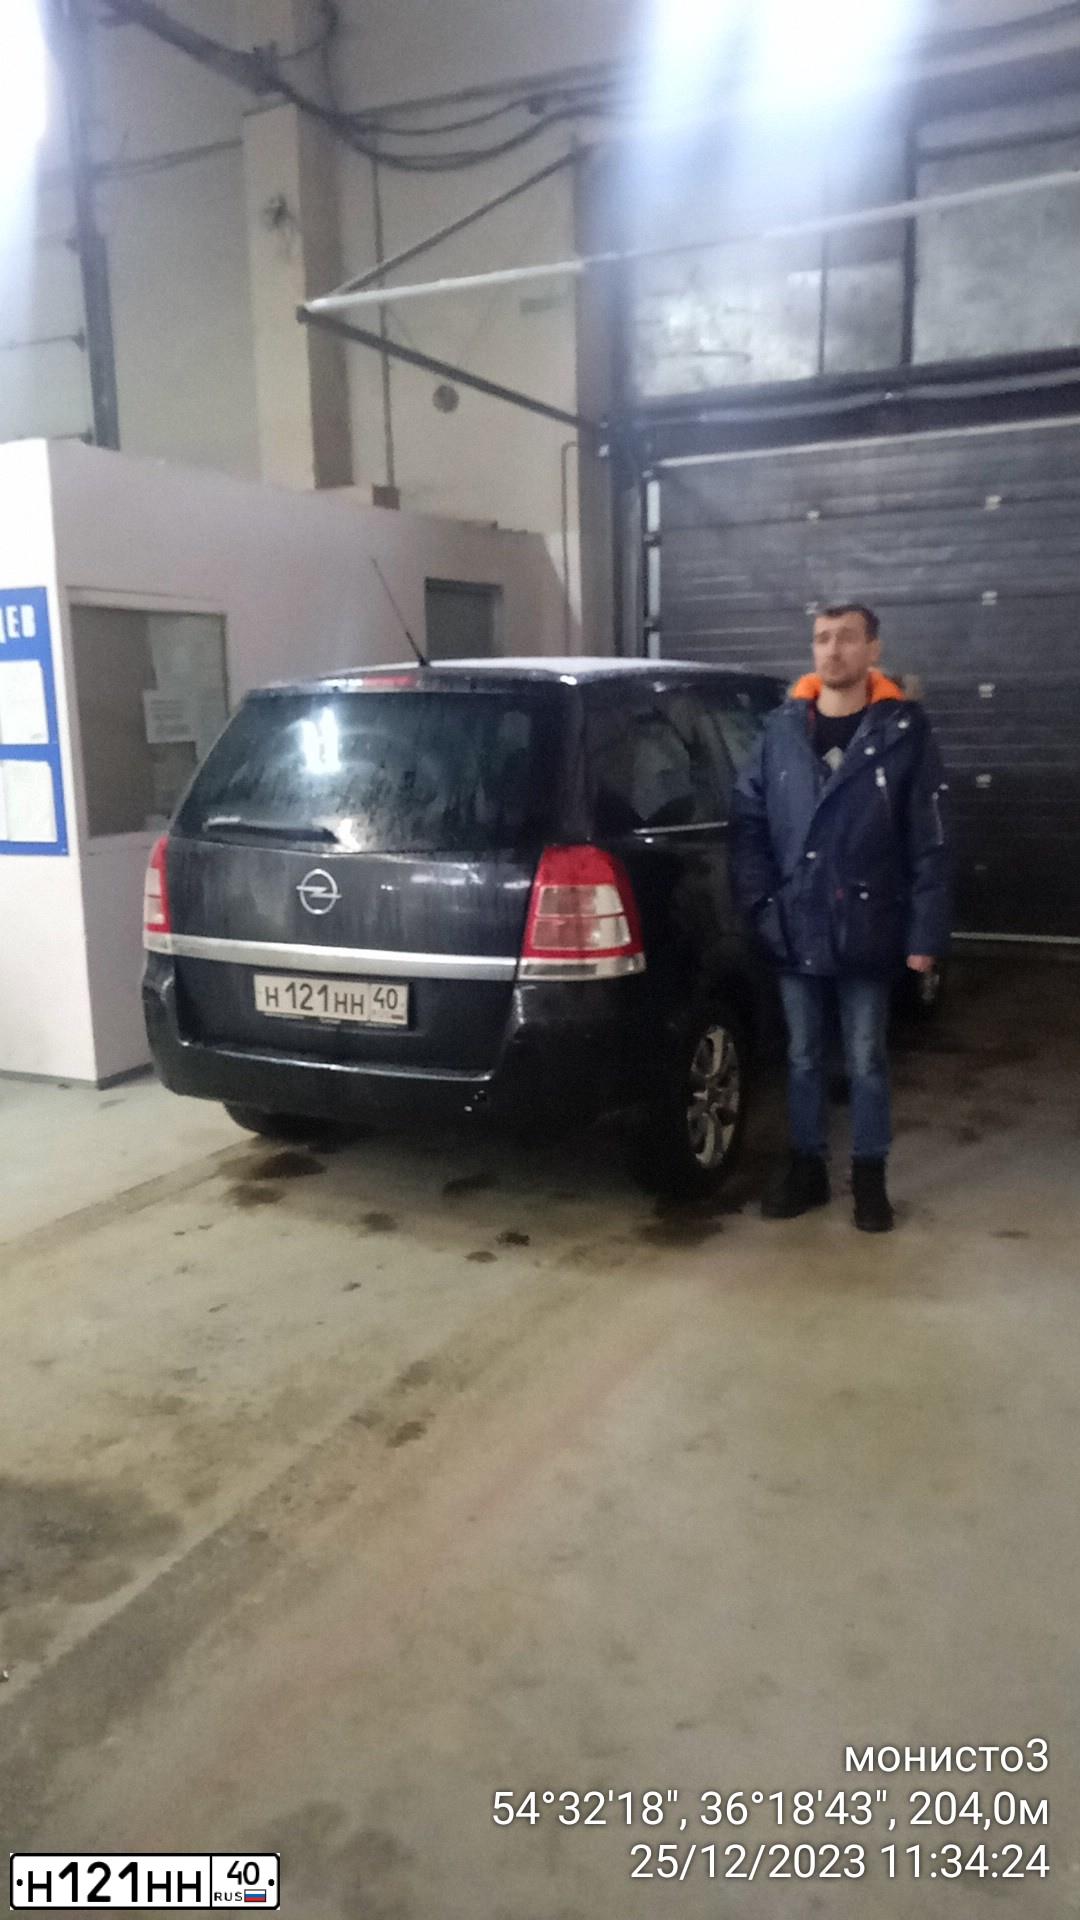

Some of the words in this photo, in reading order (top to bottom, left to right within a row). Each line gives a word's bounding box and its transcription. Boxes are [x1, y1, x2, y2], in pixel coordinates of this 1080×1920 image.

[0, 605, 36, 644] ЕВ
[265, 982, 364, 1015] Н121НН
[373, 987, 399, 1010] 40
